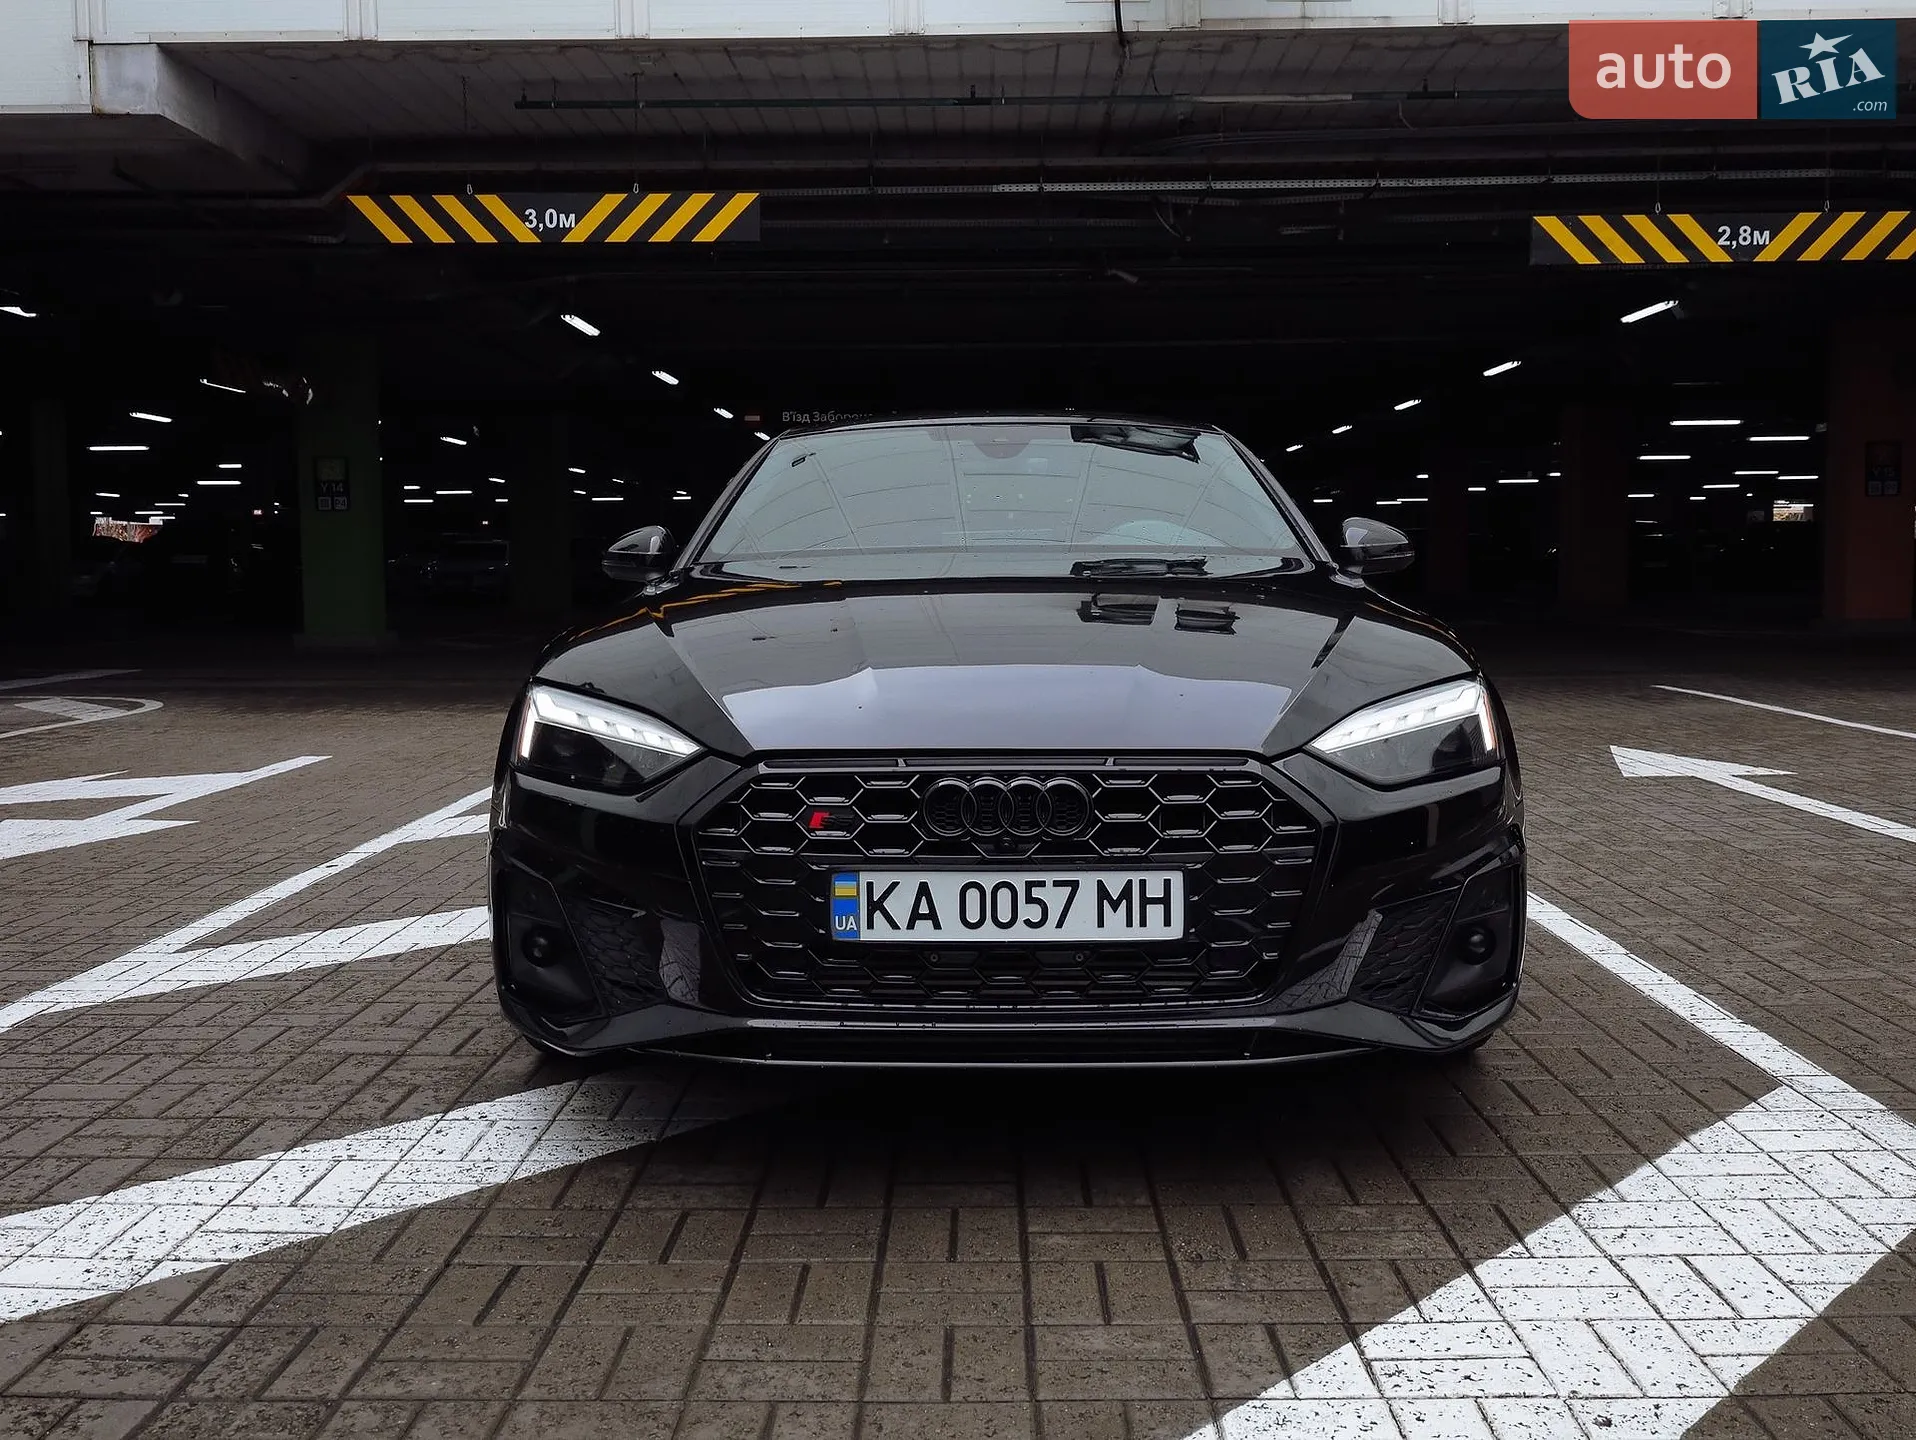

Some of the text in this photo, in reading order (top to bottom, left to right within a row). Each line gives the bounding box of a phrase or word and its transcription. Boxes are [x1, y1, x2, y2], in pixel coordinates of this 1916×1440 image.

[524, 208, 576, 232] 3,0м
[1717, 225, 1770, 249] 2,8м
[865, 878, 1172, 930] KA 0057 MH
[835, 915, 857, 931] UA
